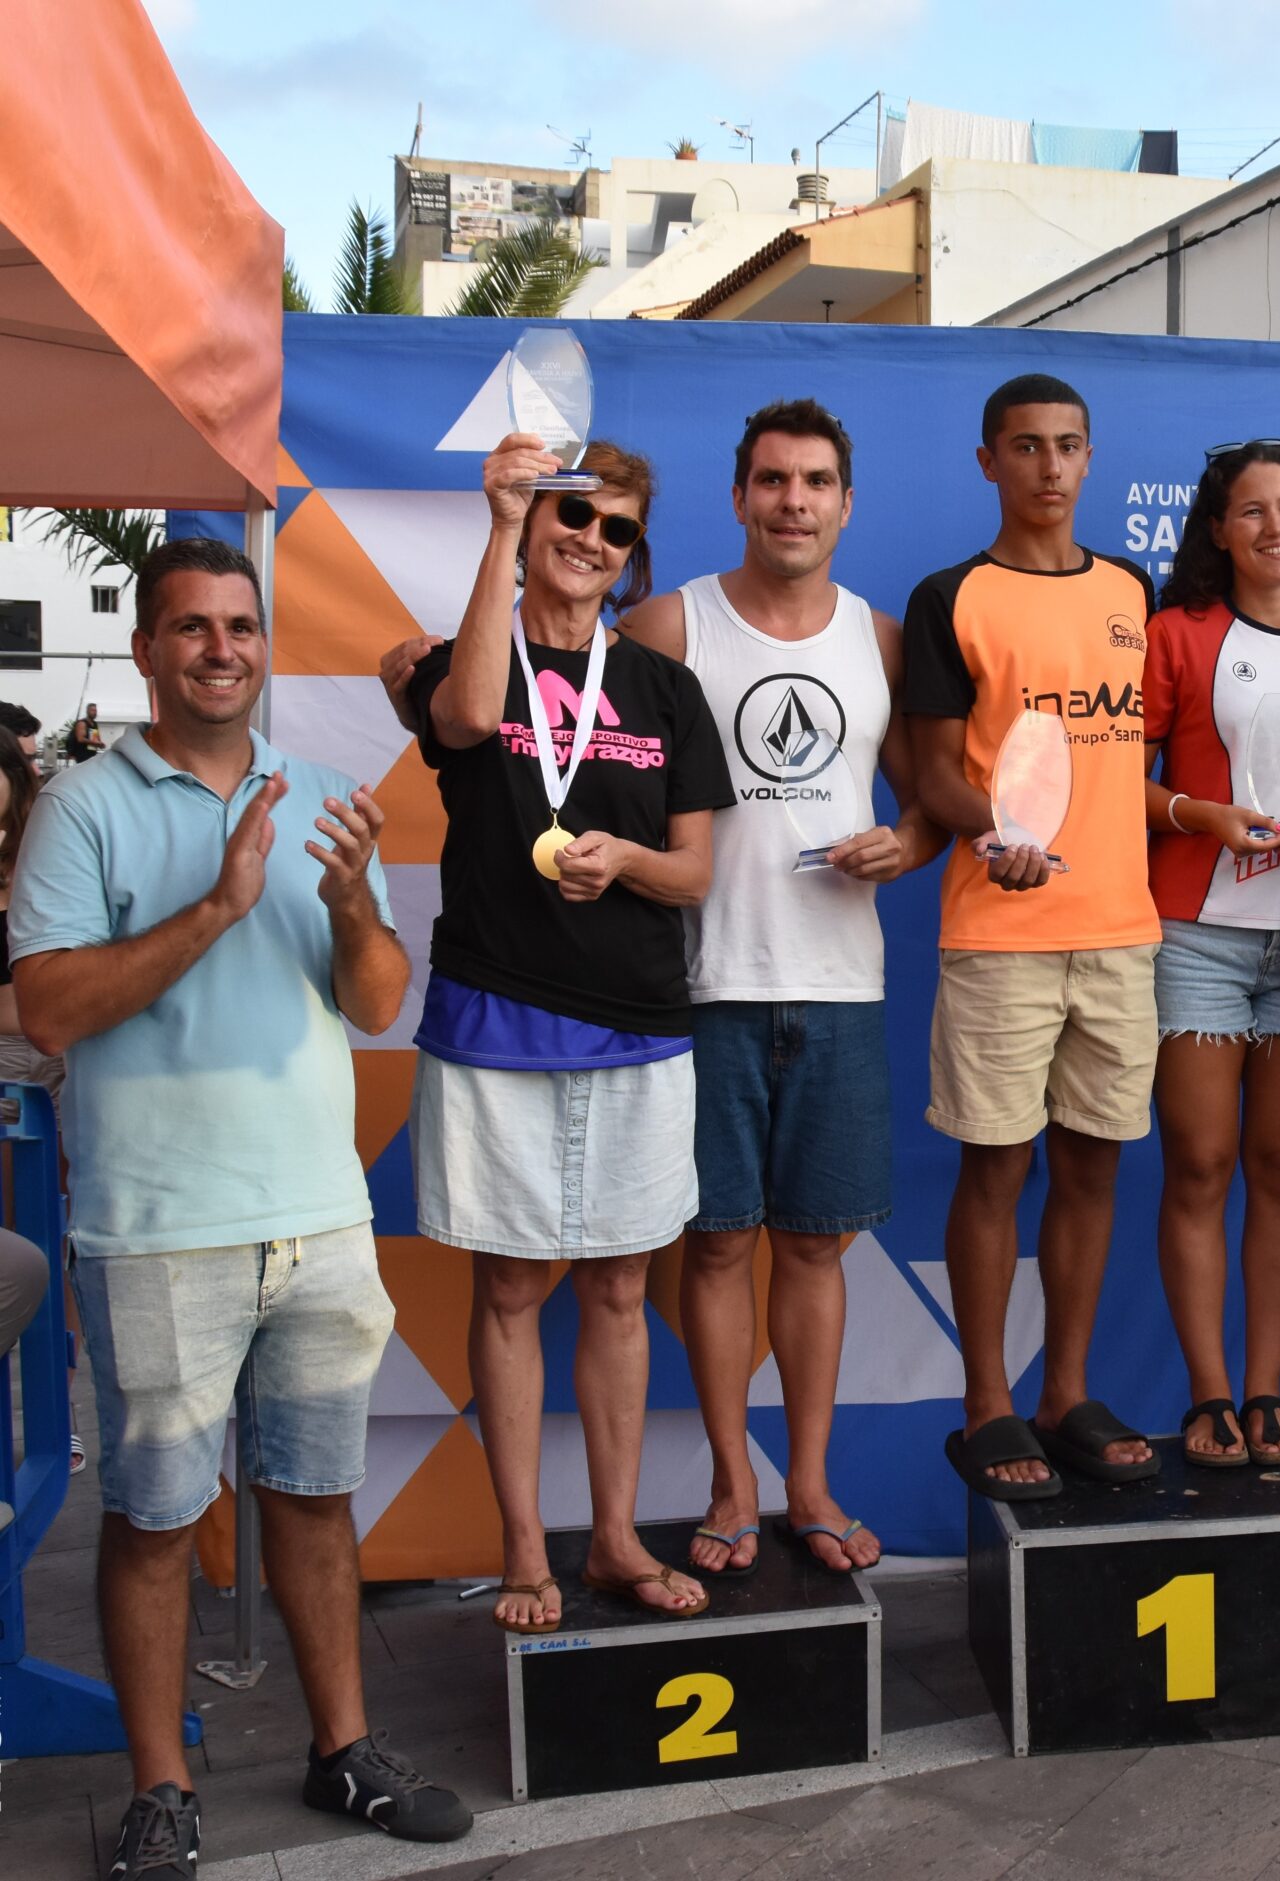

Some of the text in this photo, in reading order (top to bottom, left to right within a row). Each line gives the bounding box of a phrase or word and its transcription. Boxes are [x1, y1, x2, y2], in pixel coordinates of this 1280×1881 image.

[590, 731, 649, 748] EPORTIVO
[740, 787, 832, 802] VOLCOM
[540, 1639, 567, 1650] CAM
[1137, 1573, 1215, 1702] 1
[656, 1672, 738, 1763] 2
